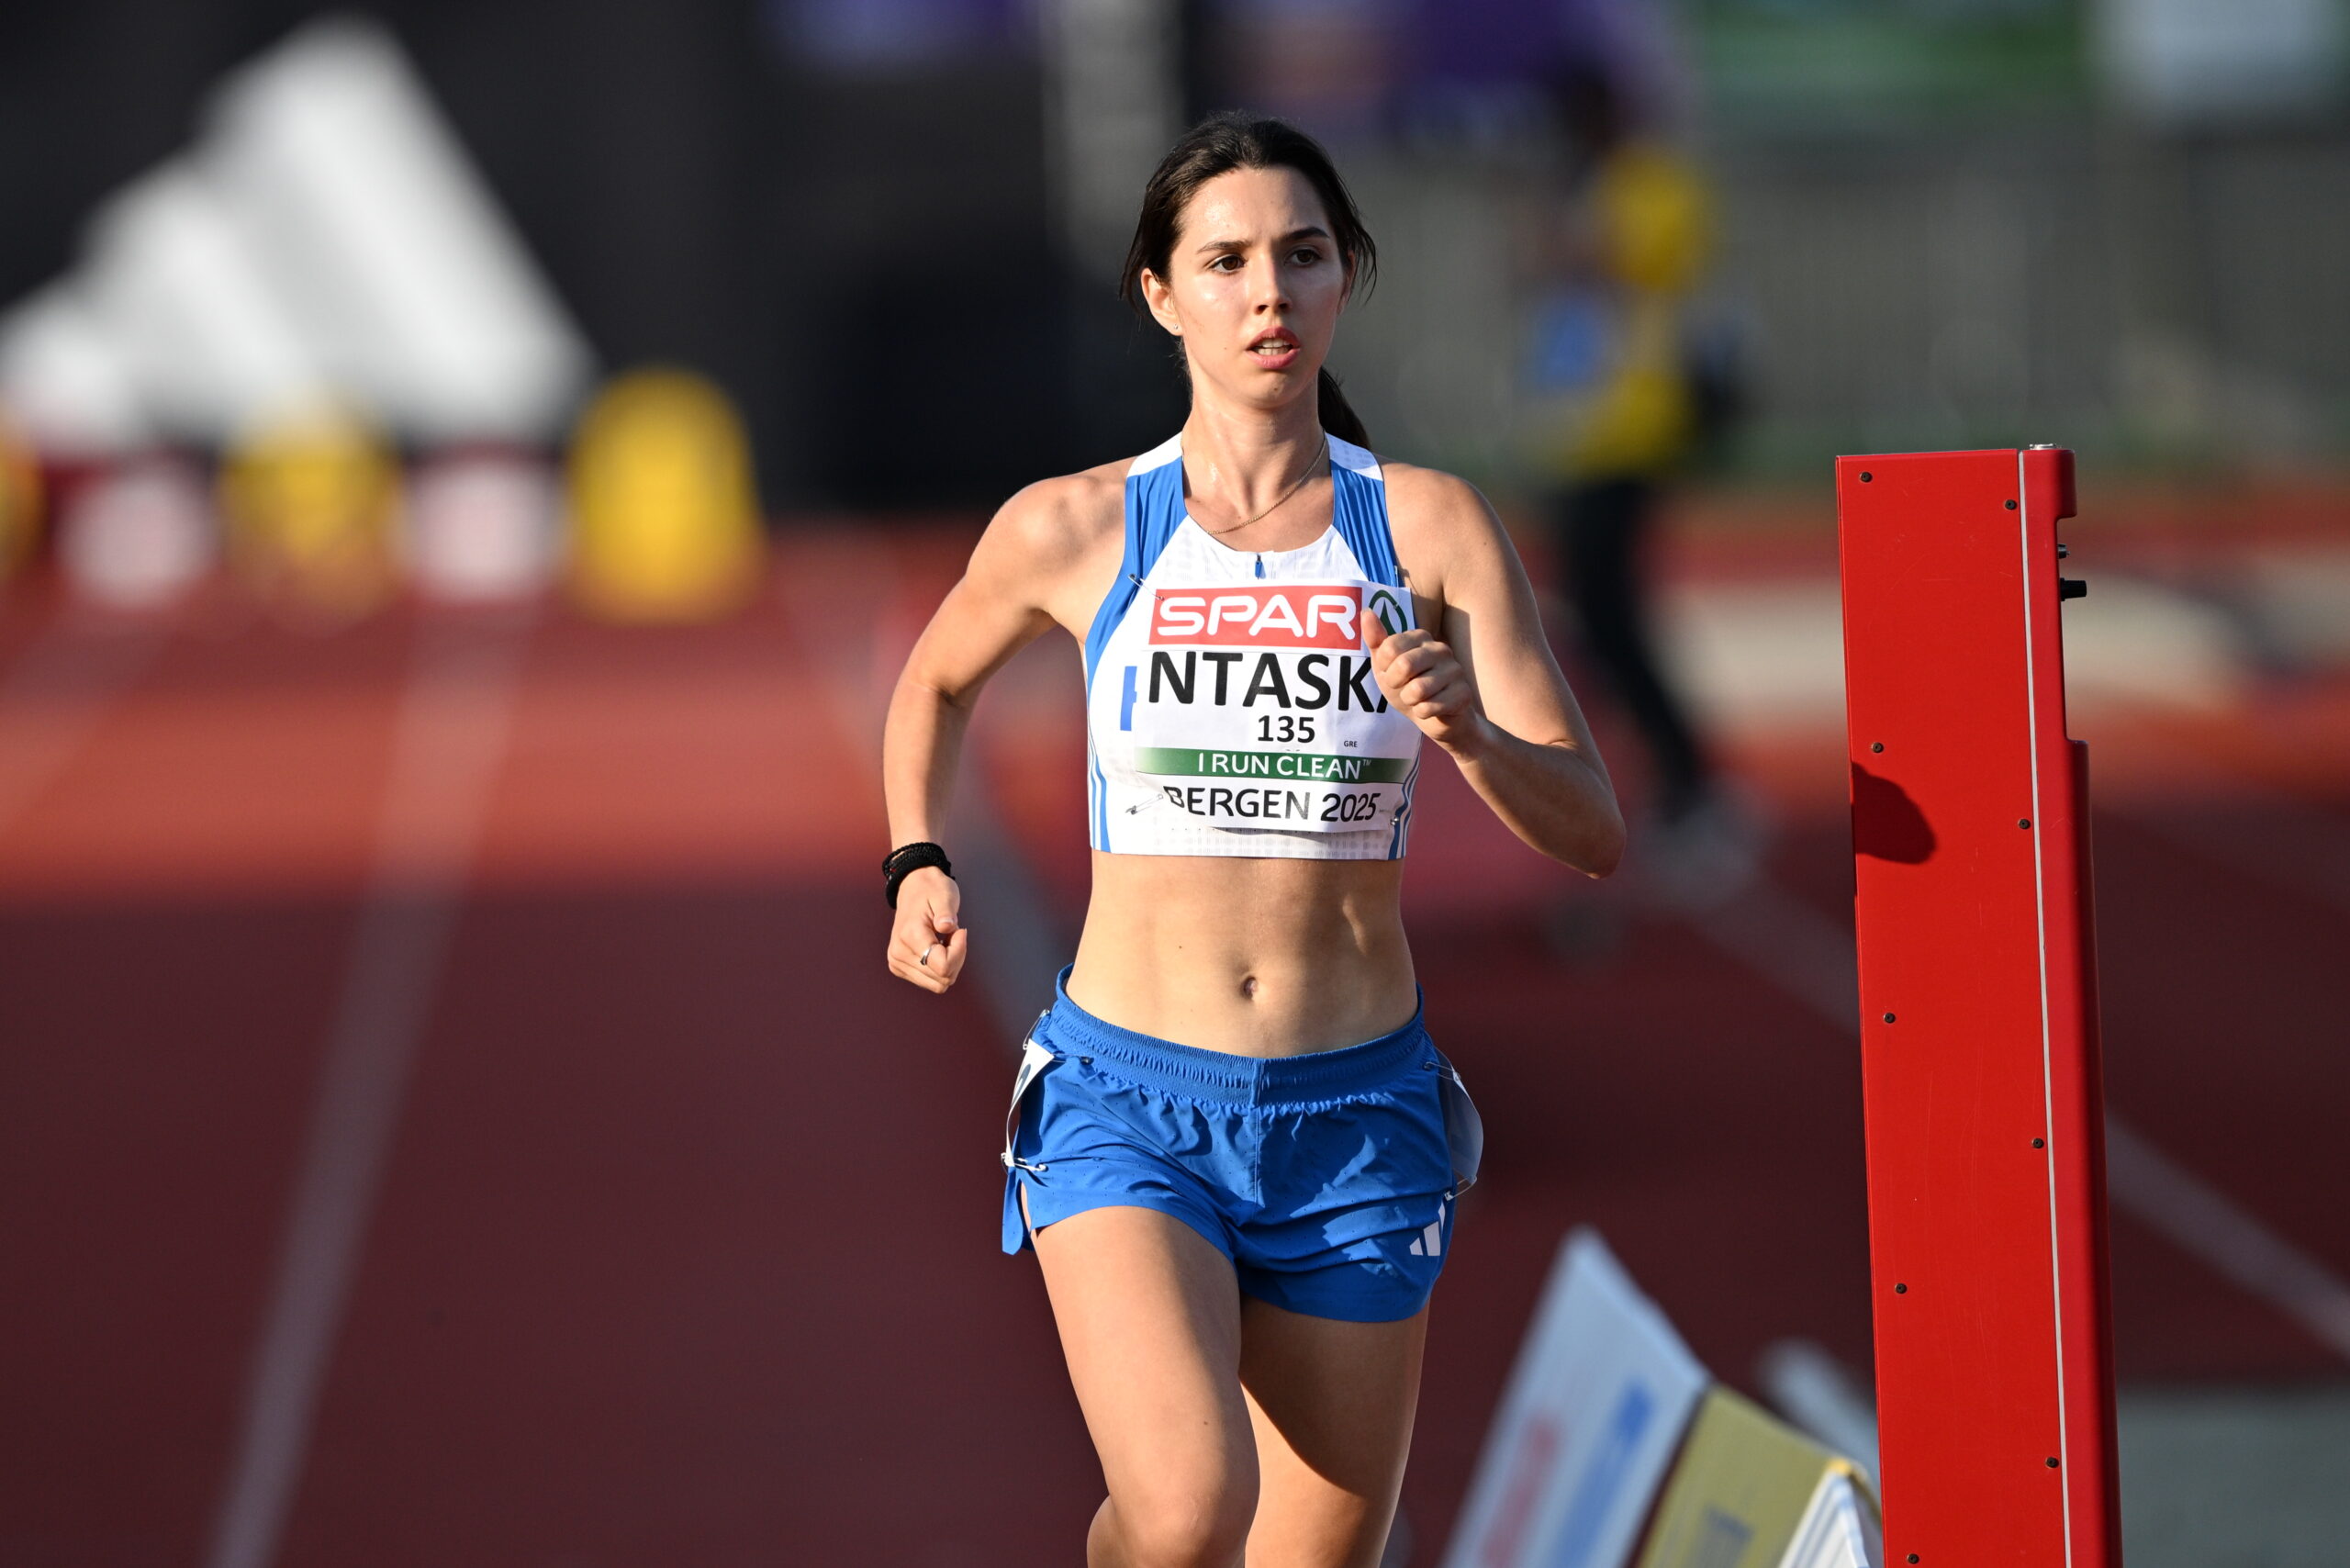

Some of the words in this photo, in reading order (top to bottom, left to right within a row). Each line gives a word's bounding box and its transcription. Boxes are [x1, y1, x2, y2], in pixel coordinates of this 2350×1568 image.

[1157, 594, 1356, 640] SPAR
[1148, 651, 1388, 713] NTASK
[1257, 715, 1315, 743] 135
[1343, 740, 1359, 748] GRE
[1198, 752, 1204, 772] I
[1212, 753, 1270, 775] RUN
[1163, 786, 1311, 820] BERGEN
[1320, 793, 1381, 822] 2025
